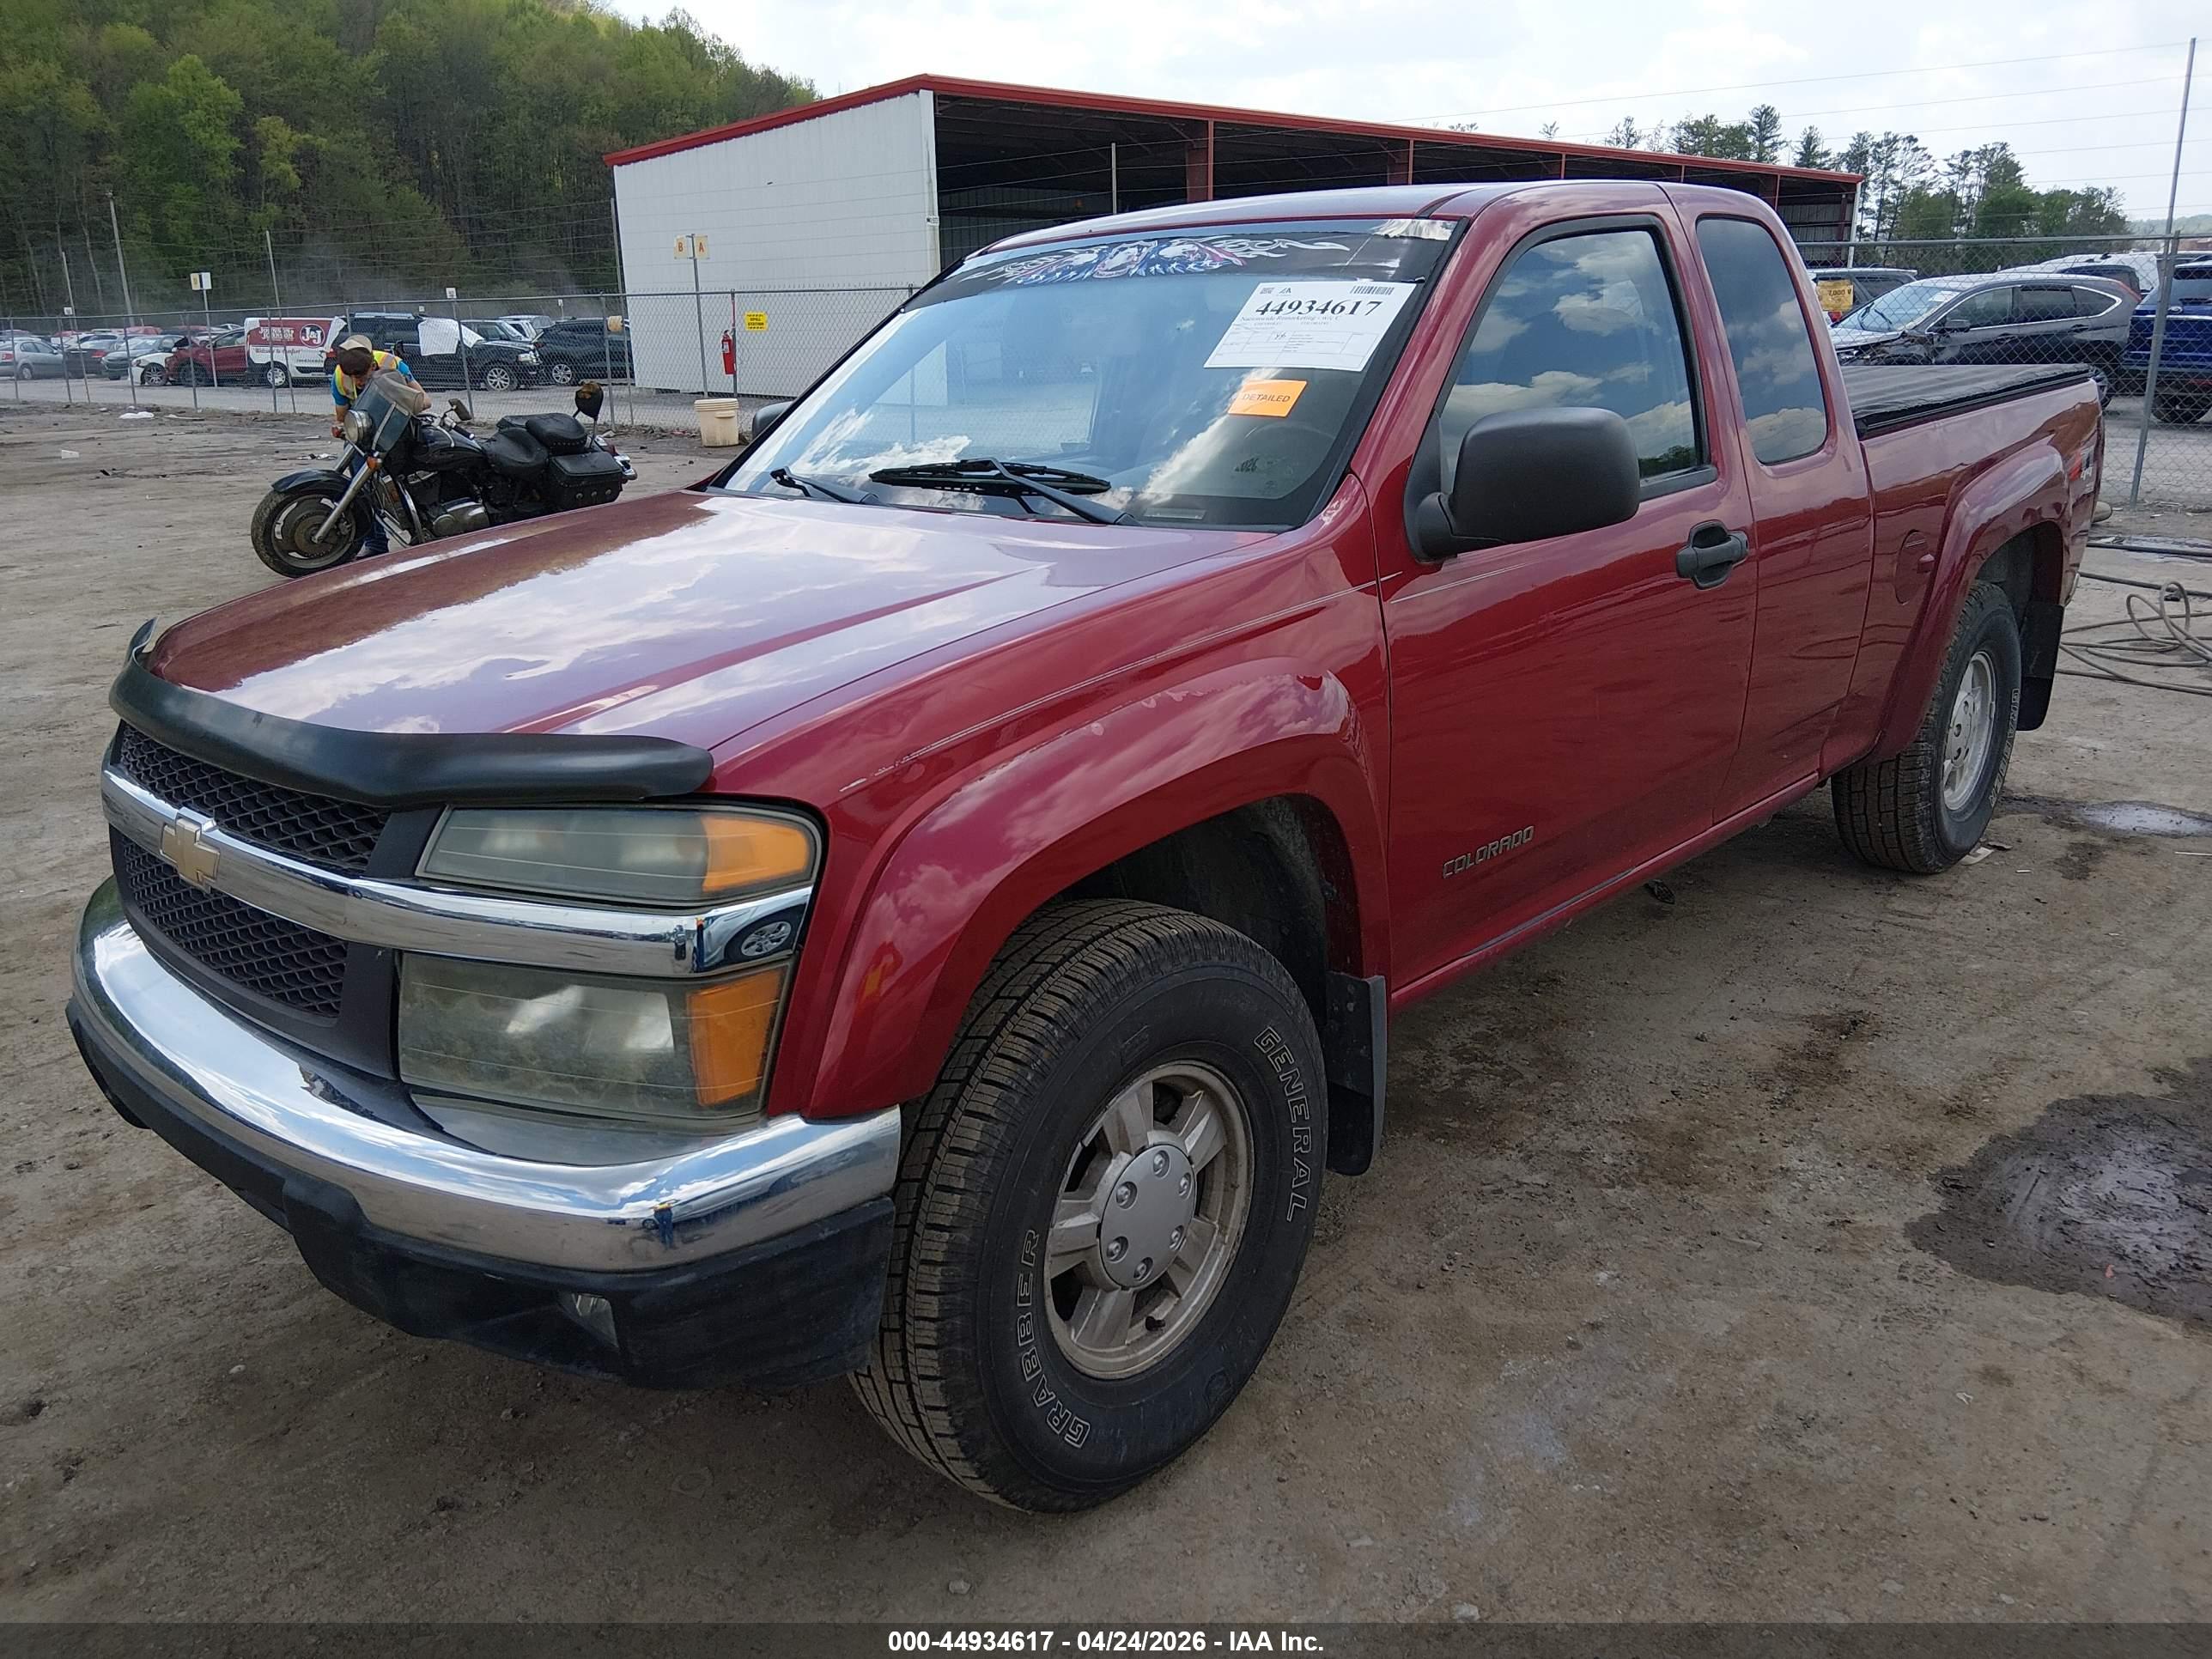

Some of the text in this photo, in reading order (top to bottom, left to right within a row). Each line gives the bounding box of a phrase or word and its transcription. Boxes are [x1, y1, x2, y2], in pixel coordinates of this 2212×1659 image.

[678, 242, 684, 252] B
[699, 242, 704, 252] A
[1255, 299, 1383, 316] 44934617
[301, 327, 322, 344] J&J
[1242, 392, 1291, 403] DETAILED
[1443, 825, 1534, 878] COLORADO
[1254, 1026, 1312, 1222] GENERAL
[1017, 1229, 1091, 1448] GRABBER
